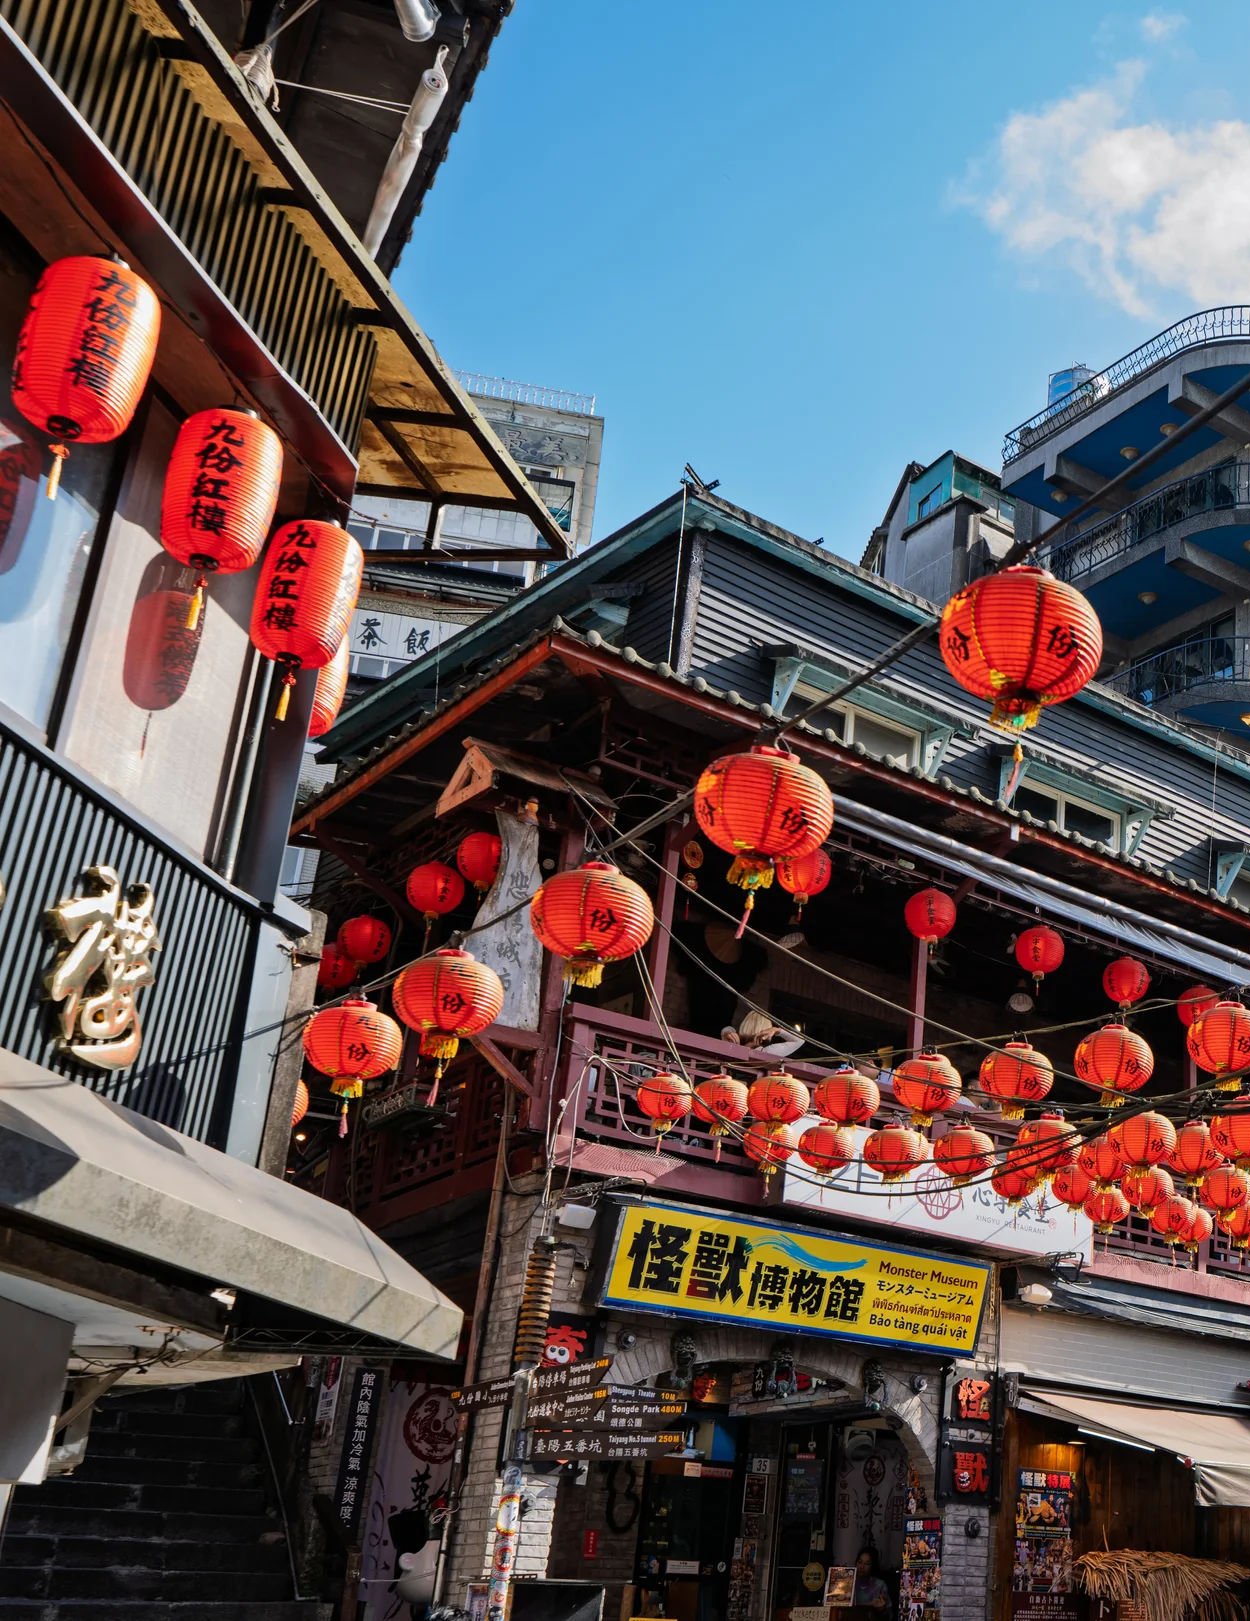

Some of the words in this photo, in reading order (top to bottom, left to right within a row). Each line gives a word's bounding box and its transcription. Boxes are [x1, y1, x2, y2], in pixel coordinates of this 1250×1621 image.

[442, 961, 477, 1015] 九份
[347, 1014, 378, 1063] 九份
[975, 1213, 1001, 1226] XINGYU
[1004, 1219, 1047, 1236] RESTAURANT
[627, 1219, 865, 1324] 怪獸博物館
[878, 1259, 928, 1283] Monster
[930, 1270, 979, 1290] Museum
[876, 1279, 975, 1307] モンスターミュージアム
[869, 1312, 891, 1329] Bảo
[893, 1316, 920, 1336] tàng
[921, 1322, 947, 1339] quái
[948, 1327, 968, 1341] vật
[755, 1367, 764, 1392] 九份
[637, 1388, 656, 1399] Theater
[661, 1392, 676, 1401] 10M
[347, 1372, 376, 1471] 館內陰氣加冷氣
[611, 1405, 640, 1415] Songde
[642, 1404, 660, 1414] Park
[660, 1404, 683, 1414] 480M
[534, 1438, 603, 1455] 臺陽五番坑
[608, 1434, 629, 1444] Taiyang
[658, 1435, 680, 1443] 250M
[756, 1459, 767, 1472] 35
[1020, 1470, 1072, 1490] 怪獸特展
